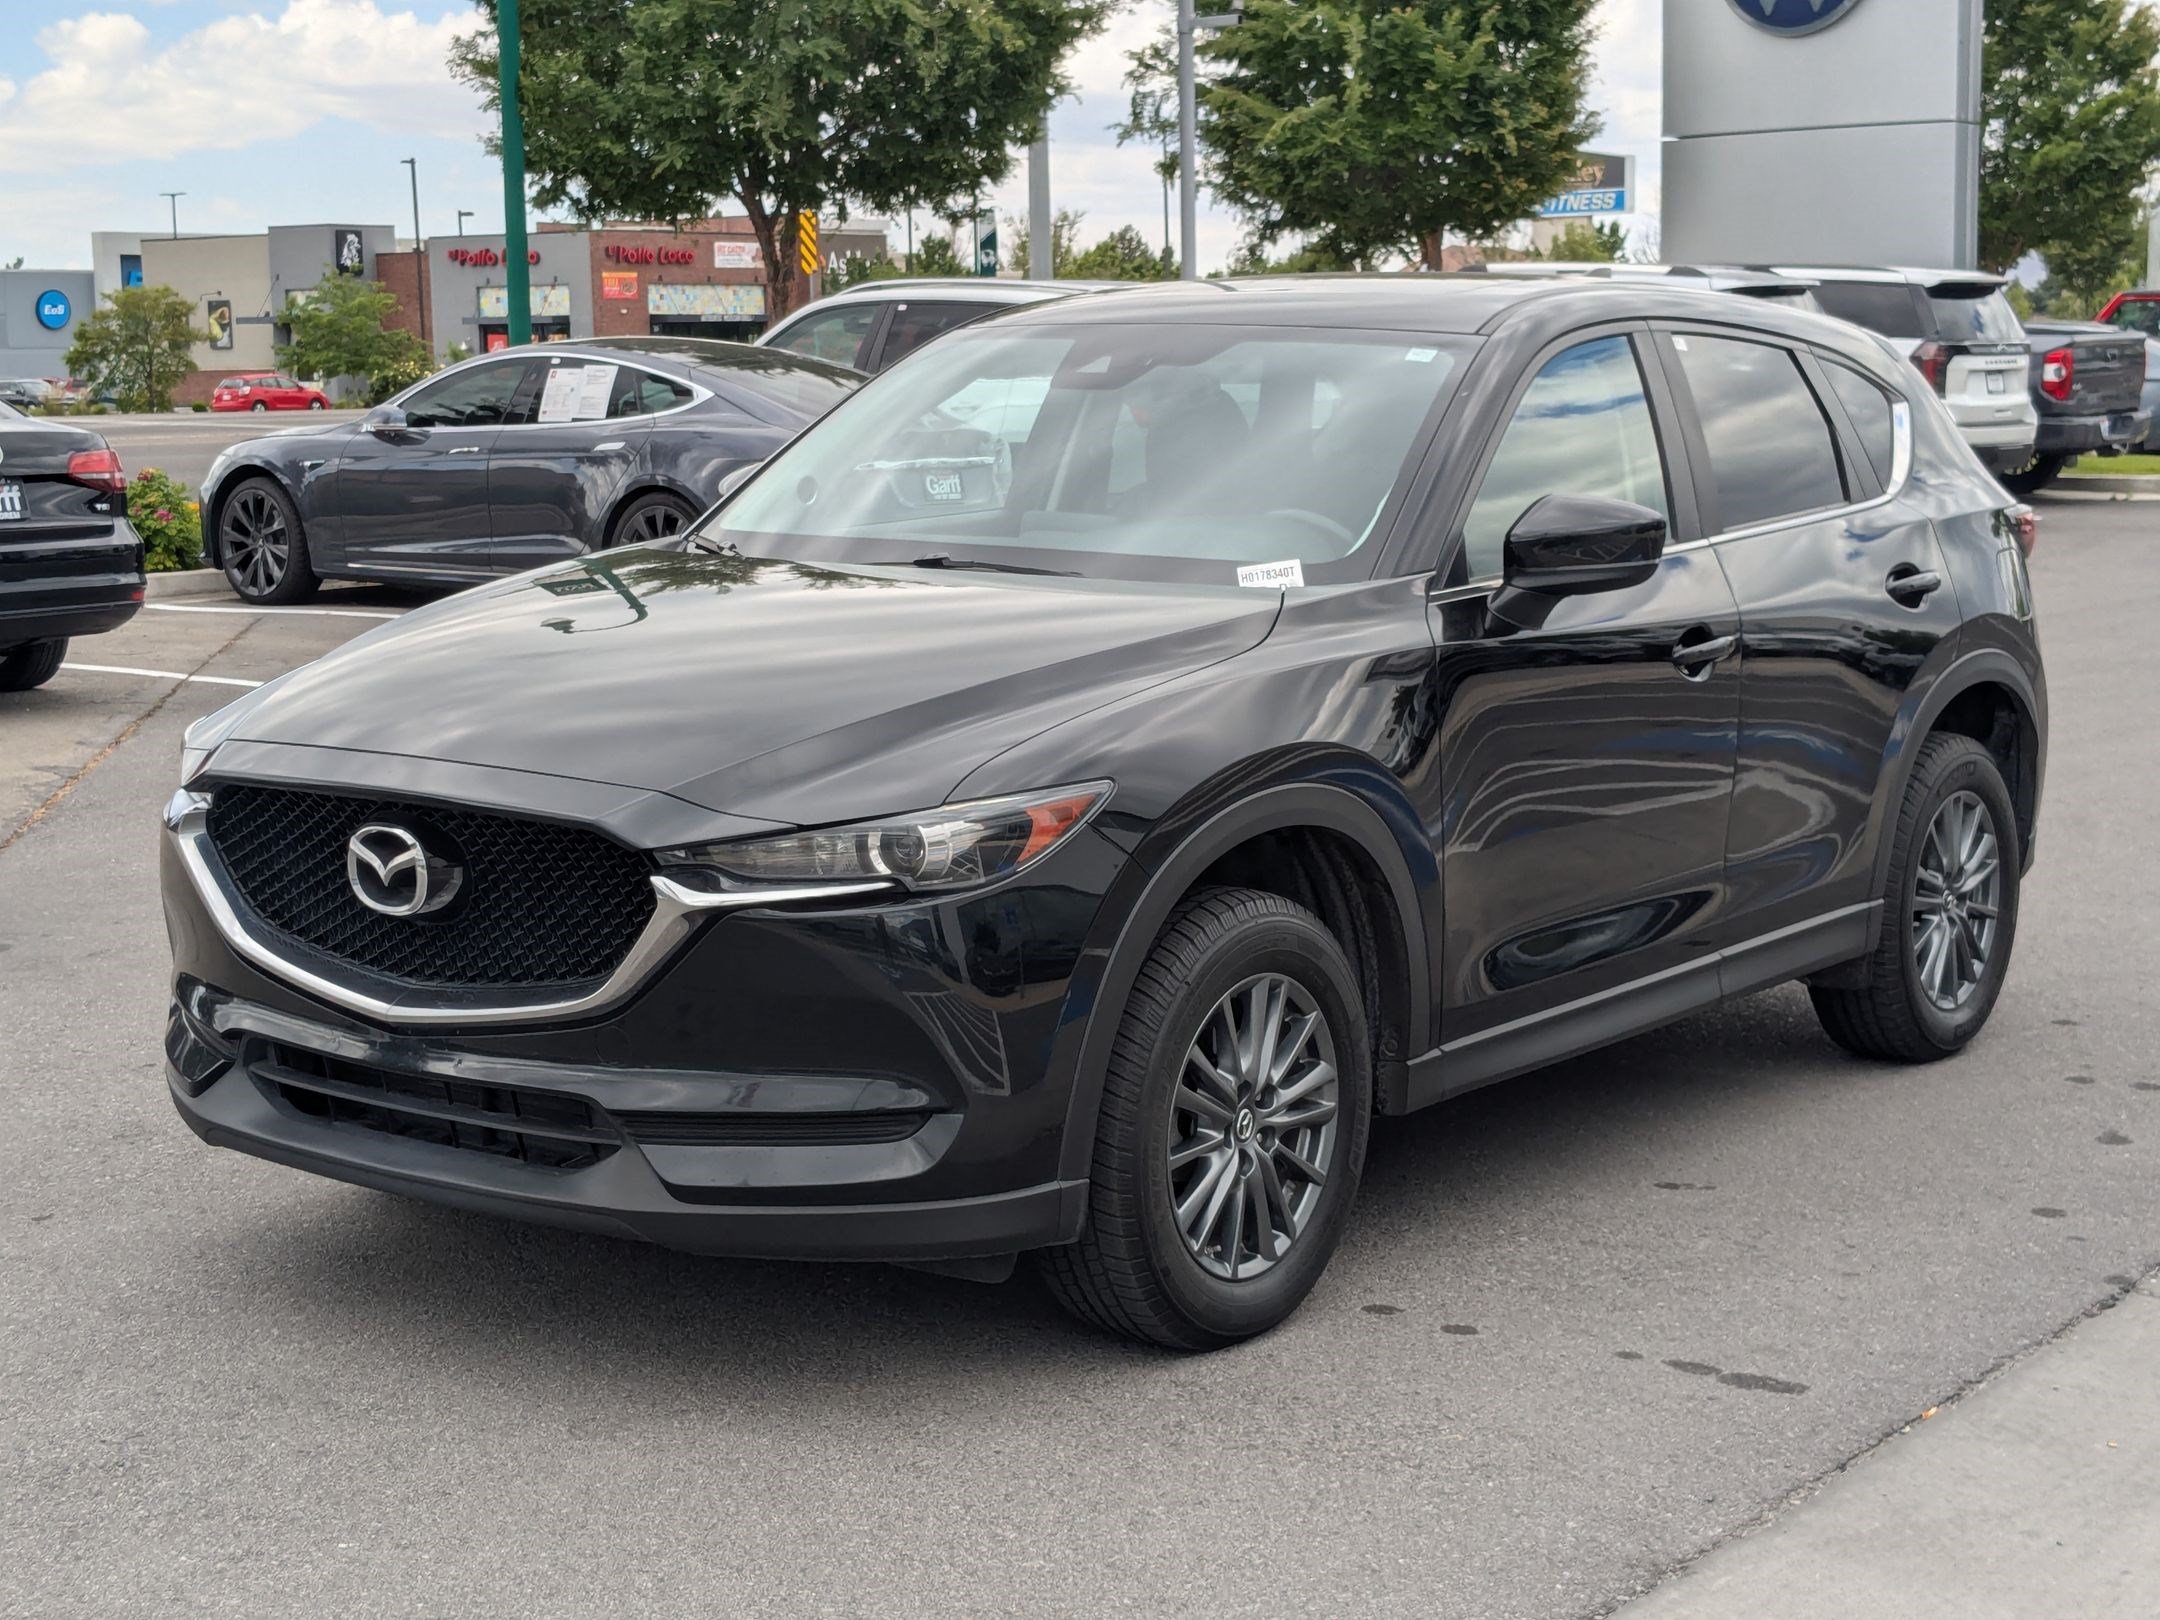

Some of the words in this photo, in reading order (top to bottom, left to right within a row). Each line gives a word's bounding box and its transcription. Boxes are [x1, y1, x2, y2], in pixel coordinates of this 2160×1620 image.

[458, 249, 497, 266] Pollo
[617, 246, 656, 265] Pollo
[658, 246, 697, 265] Loco
[1241, 566, 1295, 583] H0178340T
